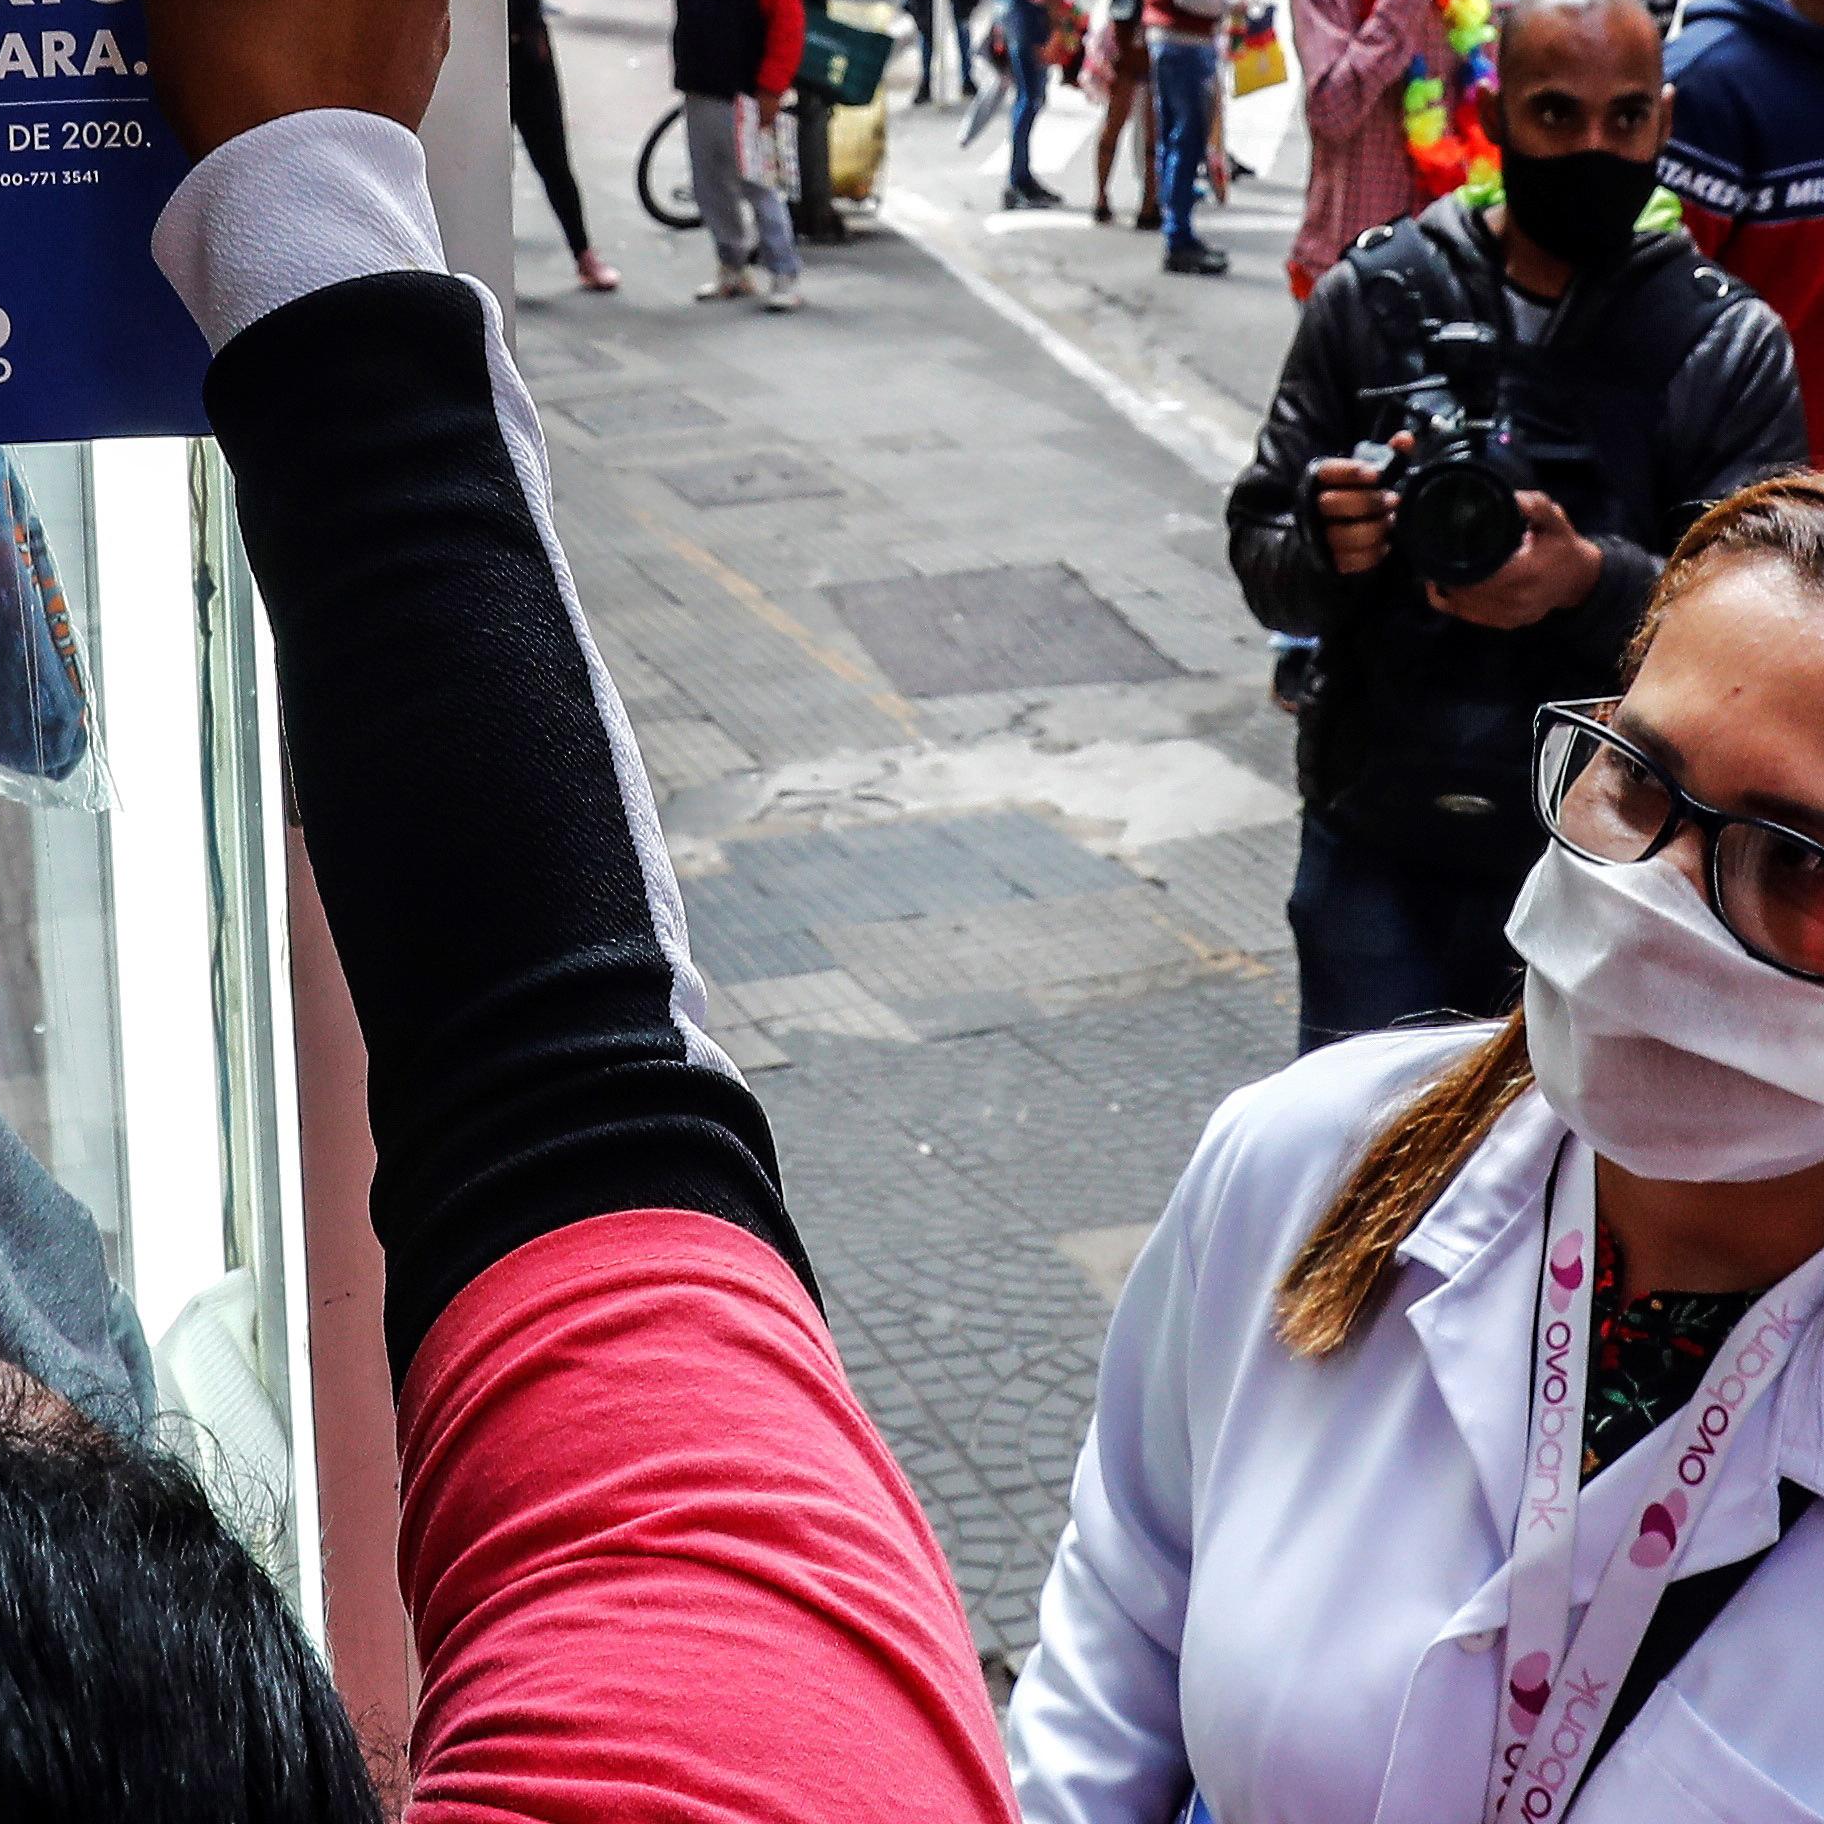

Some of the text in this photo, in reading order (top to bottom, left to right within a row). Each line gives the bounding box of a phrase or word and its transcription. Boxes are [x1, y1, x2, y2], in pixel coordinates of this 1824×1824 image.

[8, 122, 51, 152] DE
[61, 120, 152, 150] 2020.
[62, 170, 100, 186] 3541
[1528, 1320, 1572, 1532] ovobank
[1678, 1302, 1808, 1485] ovobank
